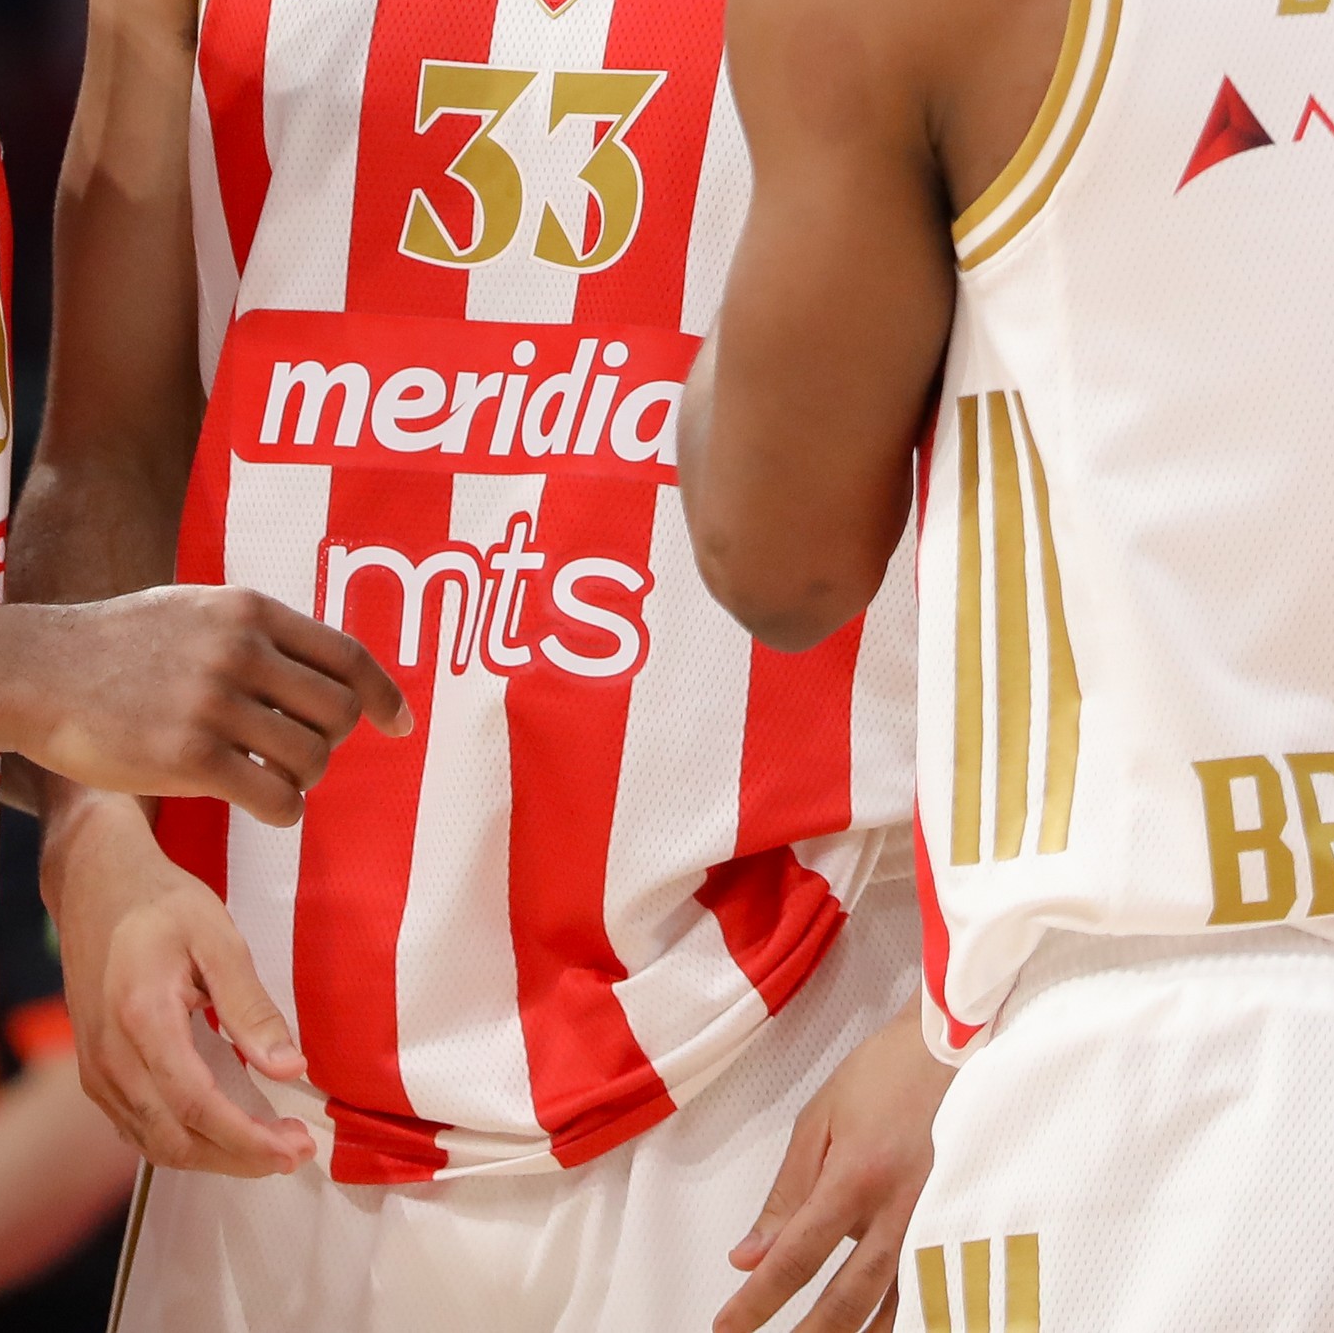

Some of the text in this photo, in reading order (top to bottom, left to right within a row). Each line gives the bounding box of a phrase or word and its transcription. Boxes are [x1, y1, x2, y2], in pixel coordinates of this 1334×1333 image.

[397, 58, 668, 275] 33
[258, 338, 687, 466] meridia
[323, 521, 645, 678] mts
